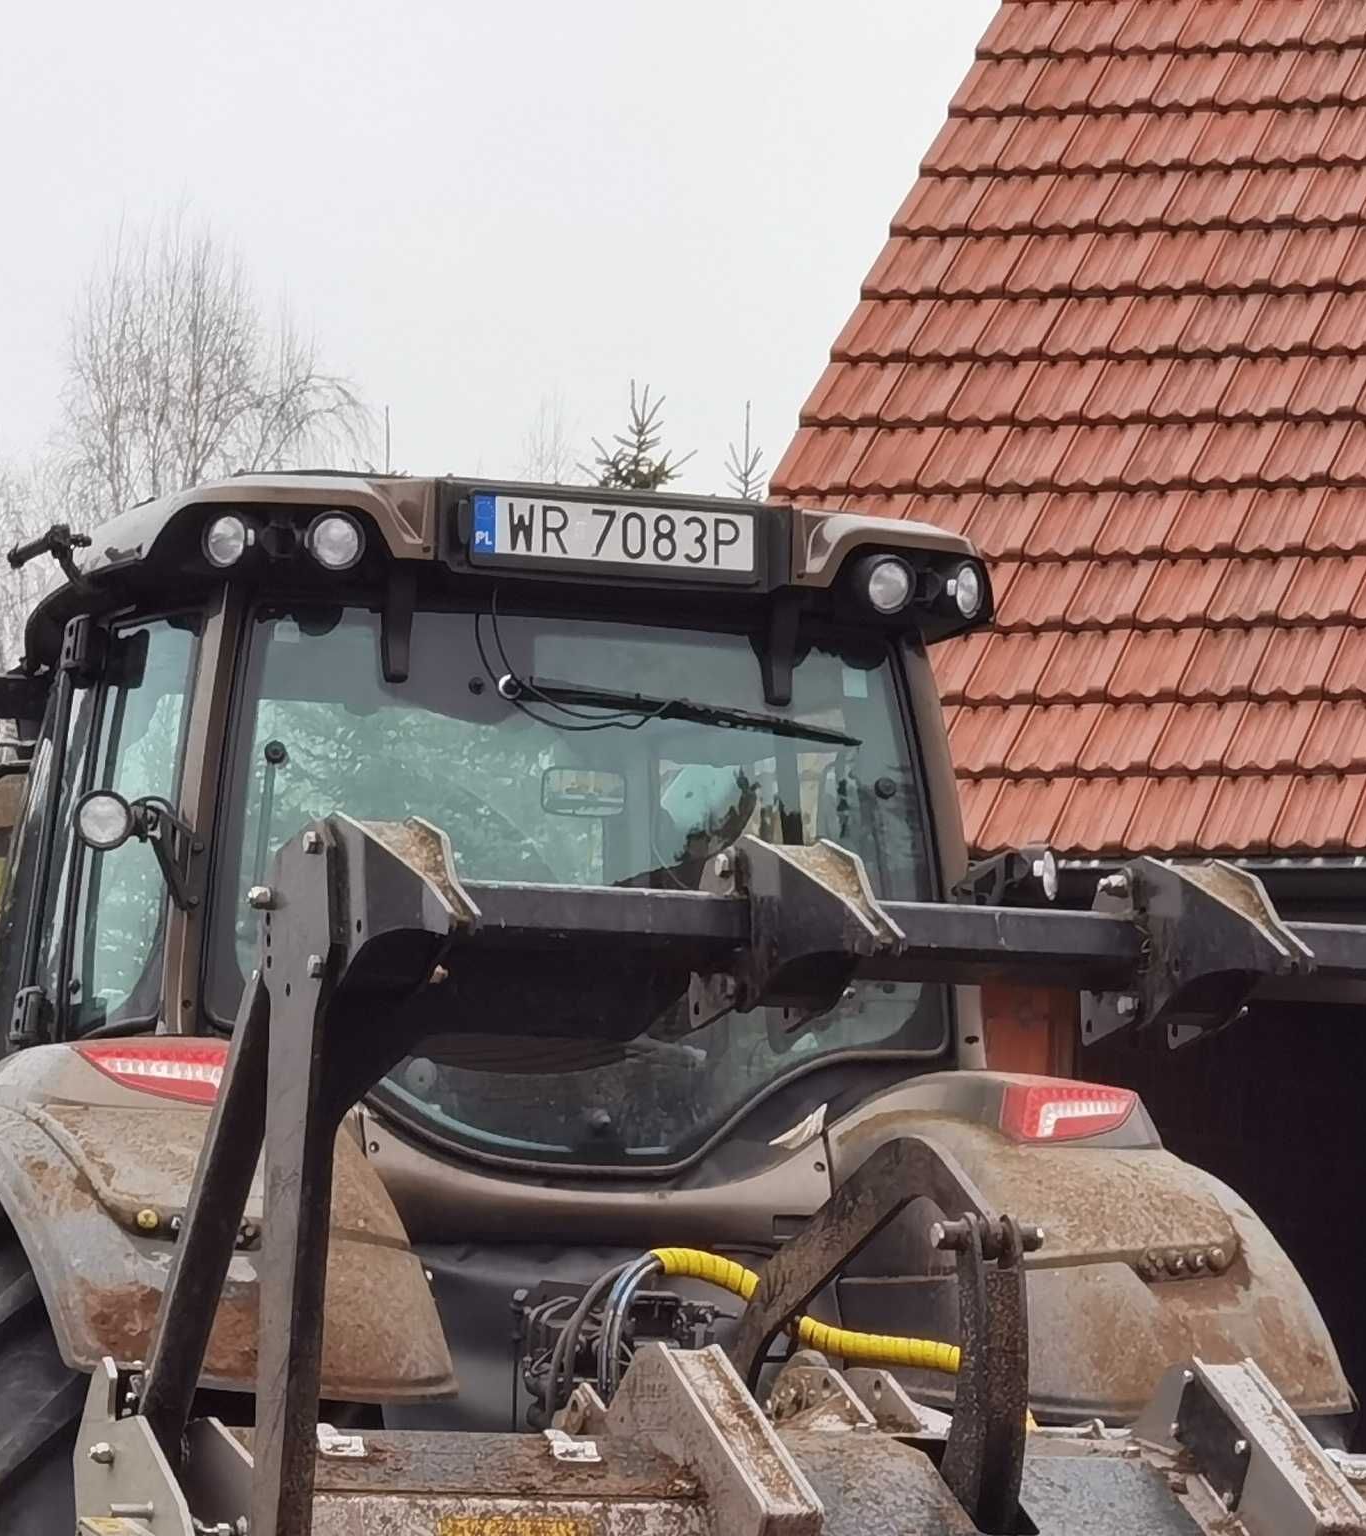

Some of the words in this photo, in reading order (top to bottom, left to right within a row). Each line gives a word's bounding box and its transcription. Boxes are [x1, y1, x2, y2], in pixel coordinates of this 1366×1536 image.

[474, 530, 493, 545] PL
[508, 502, 568, 554] WR
[591, 509, 740, 566] 7083P
